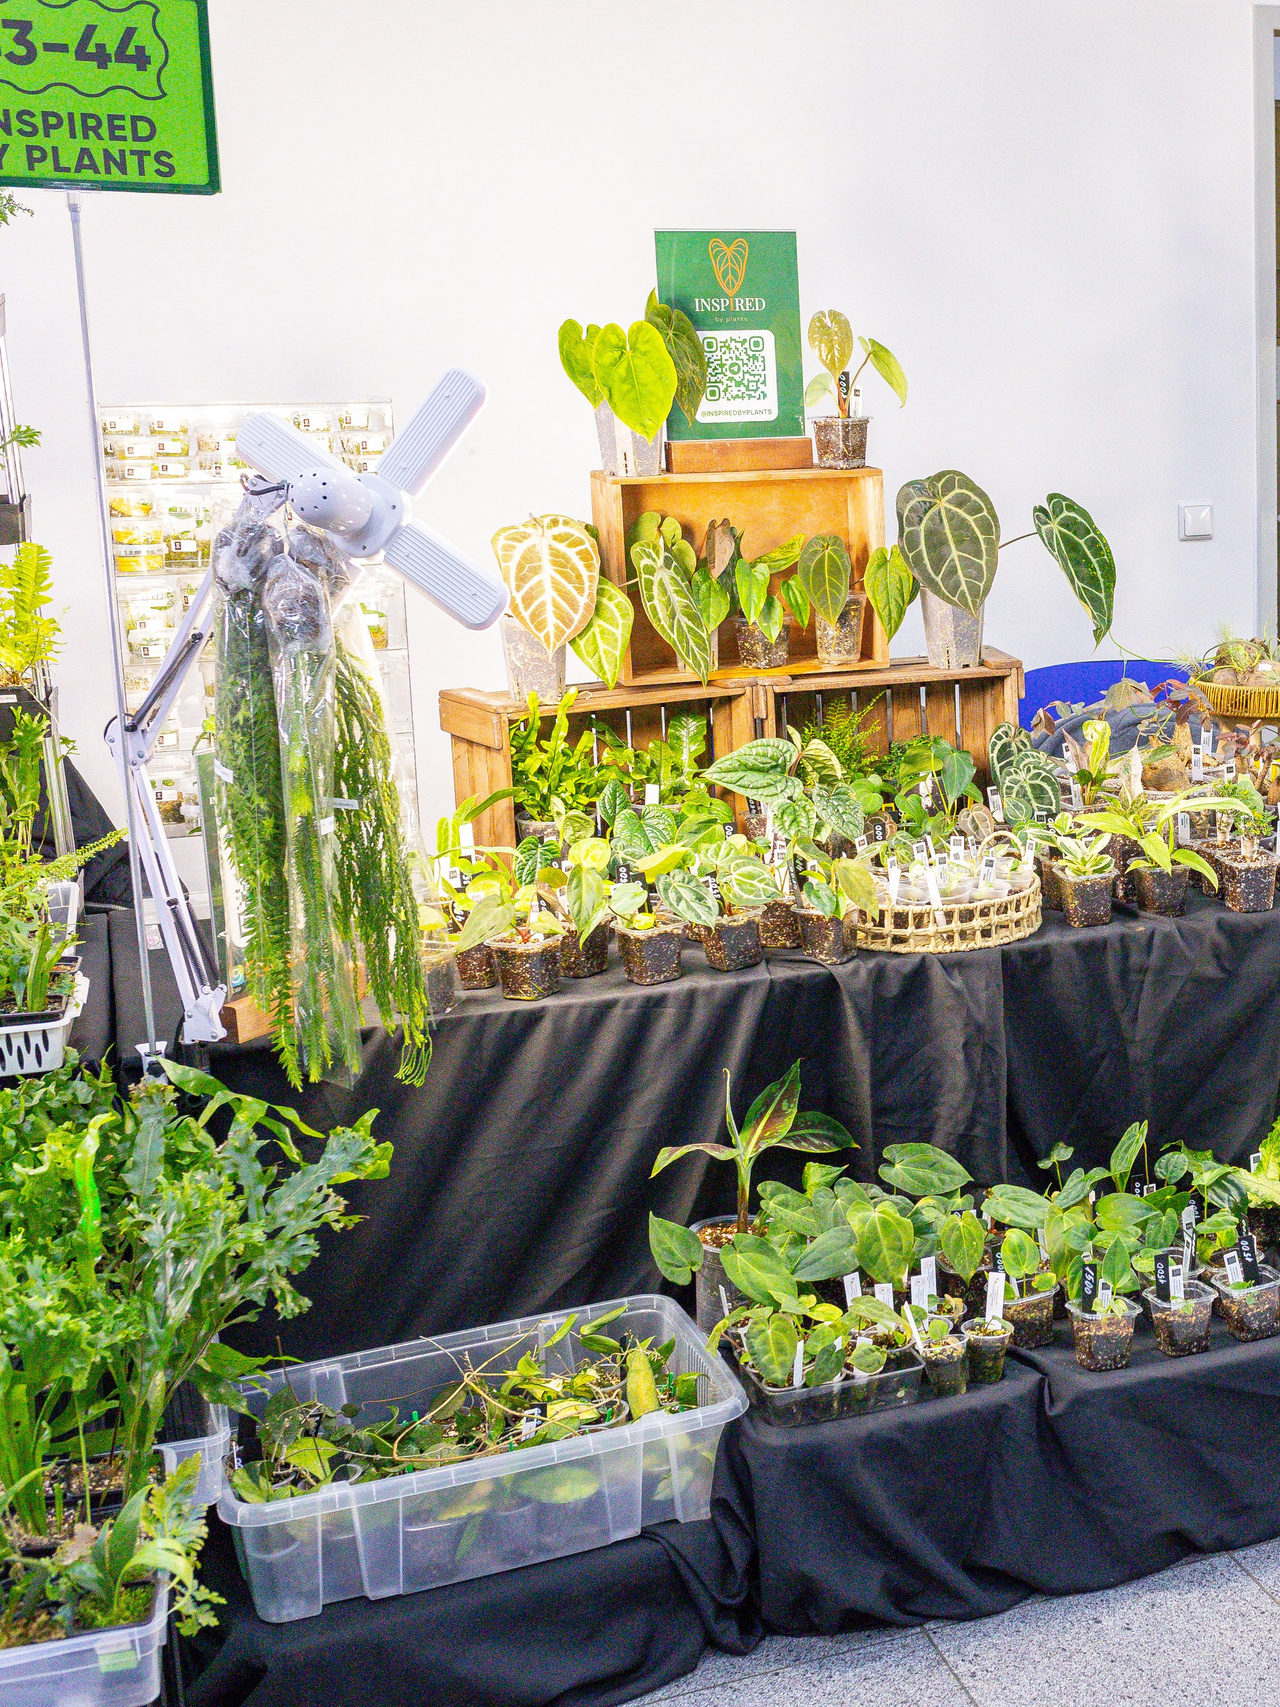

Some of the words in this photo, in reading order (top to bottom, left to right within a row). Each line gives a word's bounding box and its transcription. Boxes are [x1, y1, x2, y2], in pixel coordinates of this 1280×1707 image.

[0, 19, 152, 72] 3-44
[0, 108, 157, 143] NSPIRED
[25, 144, 176, 178] PLANTS
[694, 297, 766, 312] INSPIRED
[726, 315, 748, 323] plants
[701, 408, 773, 418] @INSPIREDBYPLANTS
[1240, 1239, 1254, 1263] 1500
[1084, 1266, 1095, 1295] 1500
[1156, 1263, 1167, 1285] 1500
